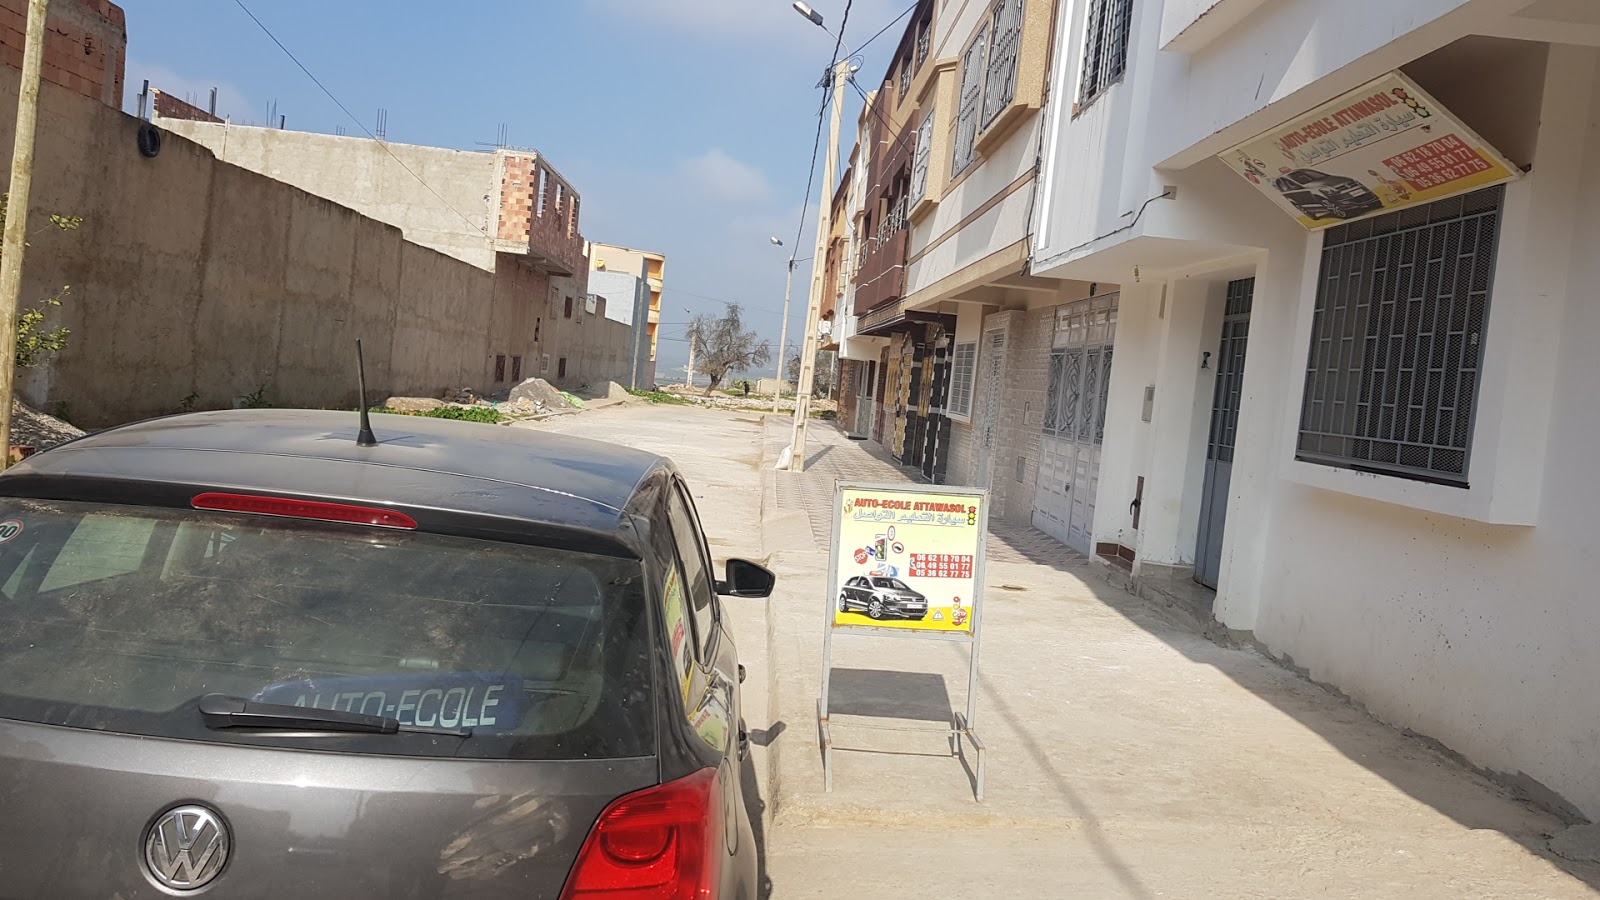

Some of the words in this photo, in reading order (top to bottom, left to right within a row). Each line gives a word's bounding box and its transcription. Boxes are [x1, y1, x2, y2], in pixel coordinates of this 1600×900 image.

[1280, 117, 1339, 149] AUTO-ECOLE
[1331, 92, 1399, 127] ATTAWASOL
[1375, 111, 1416, 132] سيارة
[1342, 121, 1381, 148] التعليم
[1390, 156, 1407, 167] 06
[1403, 152, 1420, 163] 62
[1416, 147, 1432, 158] 18
[1427, 142, 1446, 154] 70
[1442, 136, 1460, 149] 04
[1403, 166, 1420, 178] 06
[1416, 162, 1432, 173] 49
[1428, 158, 1446, 169] 55
[1441, 153, 1459, 164] 01
[1454, 147, 1472, 160] 77
[1416, 177, 1432, 188] 05
[1429, 173, 1445, 183] 36
[1441, 168, 1459, 179] 62
[1454, 163, 1472, 175] 77
[1468, 159, 1487, 170] 75
[853, 509, 895, 520] التواصل
[854, 498, 911, 510] AUTO-ECOLE
[913, 502, 966, 513] ATTAWASOL
[937, 514, 965, 525] سيارة
